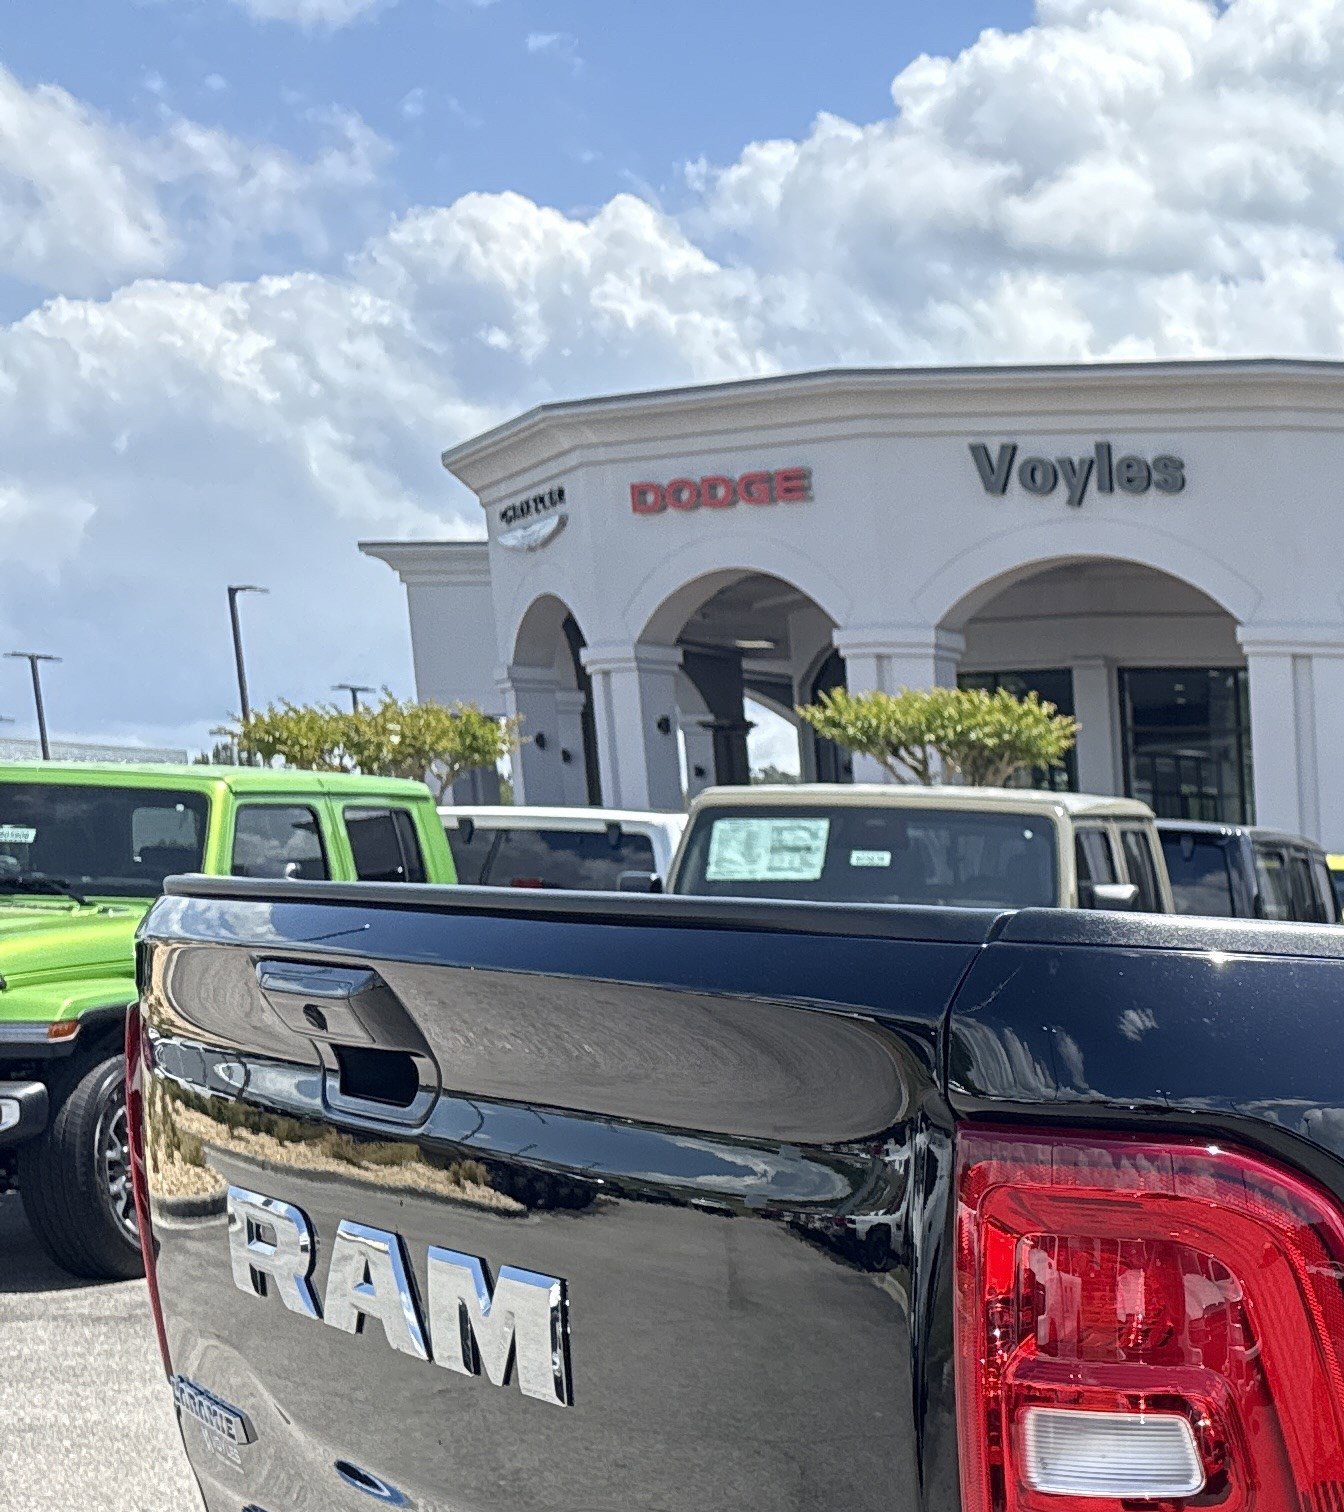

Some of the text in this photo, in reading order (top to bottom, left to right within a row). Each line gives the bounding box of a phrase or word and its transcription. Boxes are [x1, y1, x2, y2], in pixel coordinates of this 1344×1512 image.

[630, 466, 814, 515] DODGE
[968, 440, 1187, 508] Voyles
[228, 1184, 574, 1408] RAM
